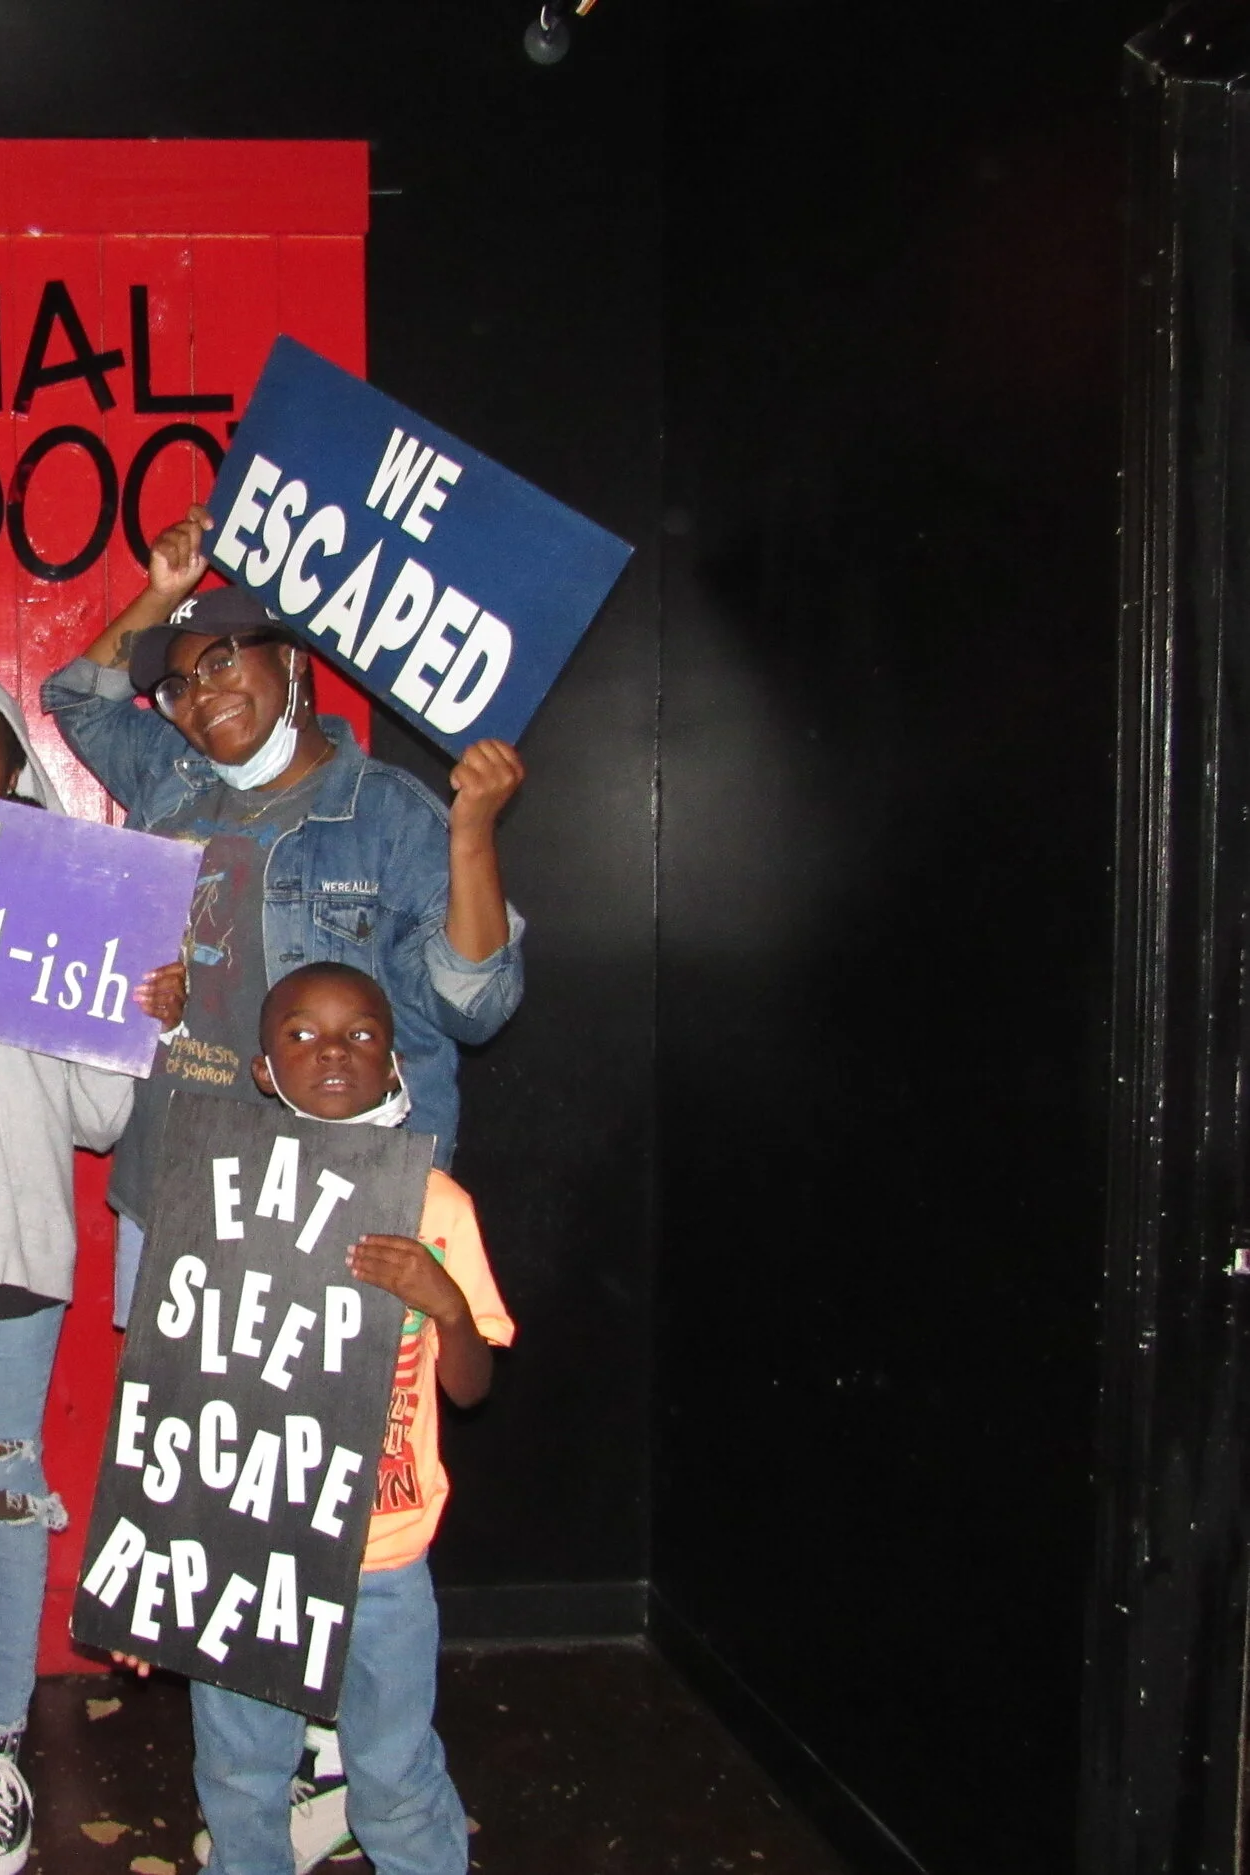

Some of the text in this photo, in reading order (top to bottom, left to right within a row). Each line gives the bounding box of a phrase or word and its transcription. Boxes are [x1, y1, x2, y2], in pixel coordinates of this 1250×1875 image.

[365, 427, 464, 544] WE
[213, 454, 513, 735] ESCAPED
[182, 1061, 237, 1087] SORROW
[213, 1136, 355, 1254] EAT
[157, 1255, 362, 1391] SLEEP
[115, 1381, 363, 1538] ESCAPE
[82, 1516, 344, 1690] REPEAT
